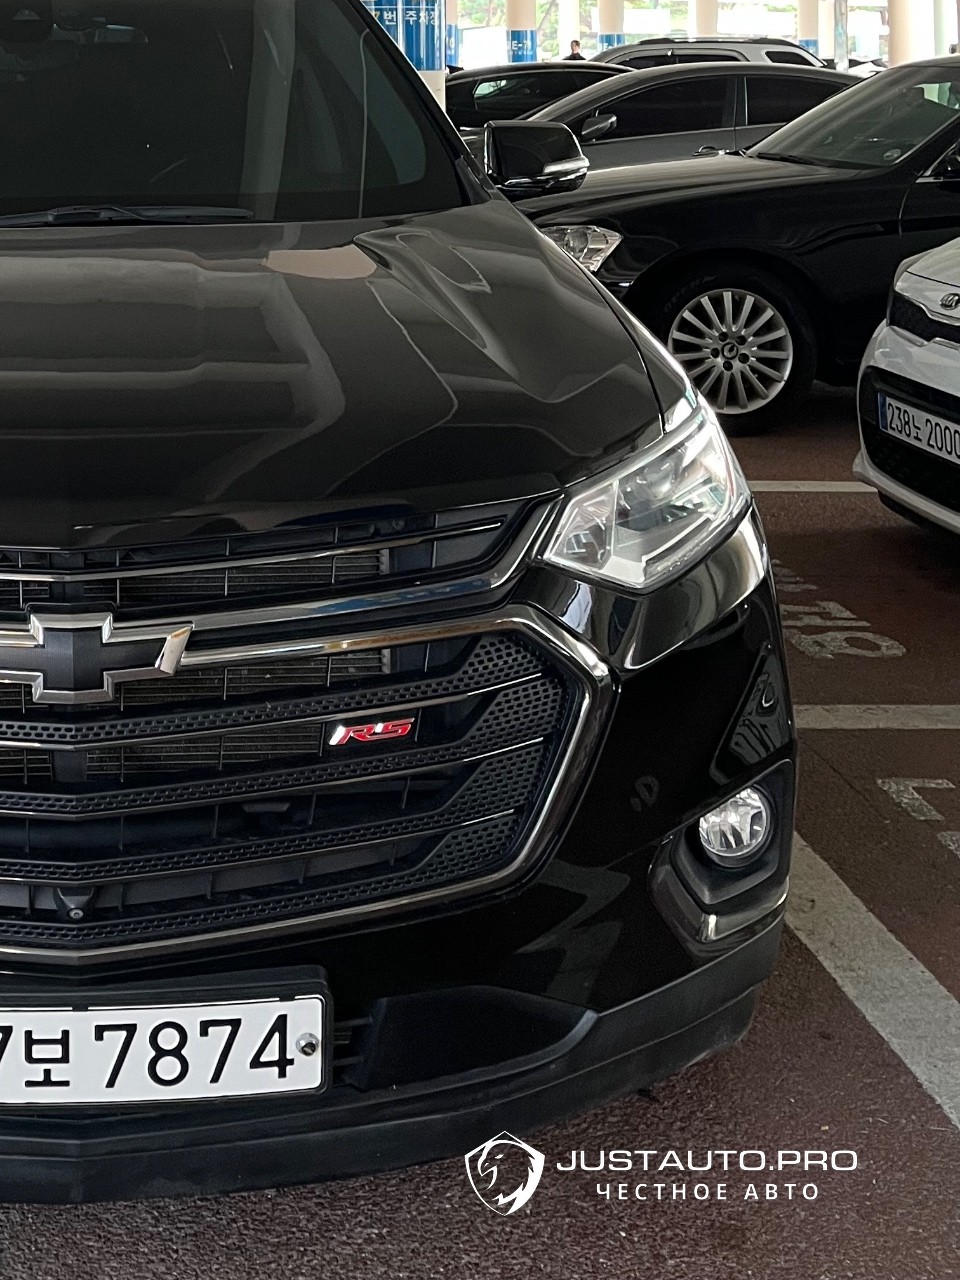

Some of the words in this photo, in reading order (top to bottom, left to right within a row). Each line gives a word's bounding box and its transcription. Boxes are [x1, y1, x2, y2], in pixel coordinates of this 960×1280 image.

[887, 401, 923, 443] 238노
[925, 418, 960, 460] 2000
[328, 718, 416, 746] RS
[94, 1013, 295, 1089] 7874
